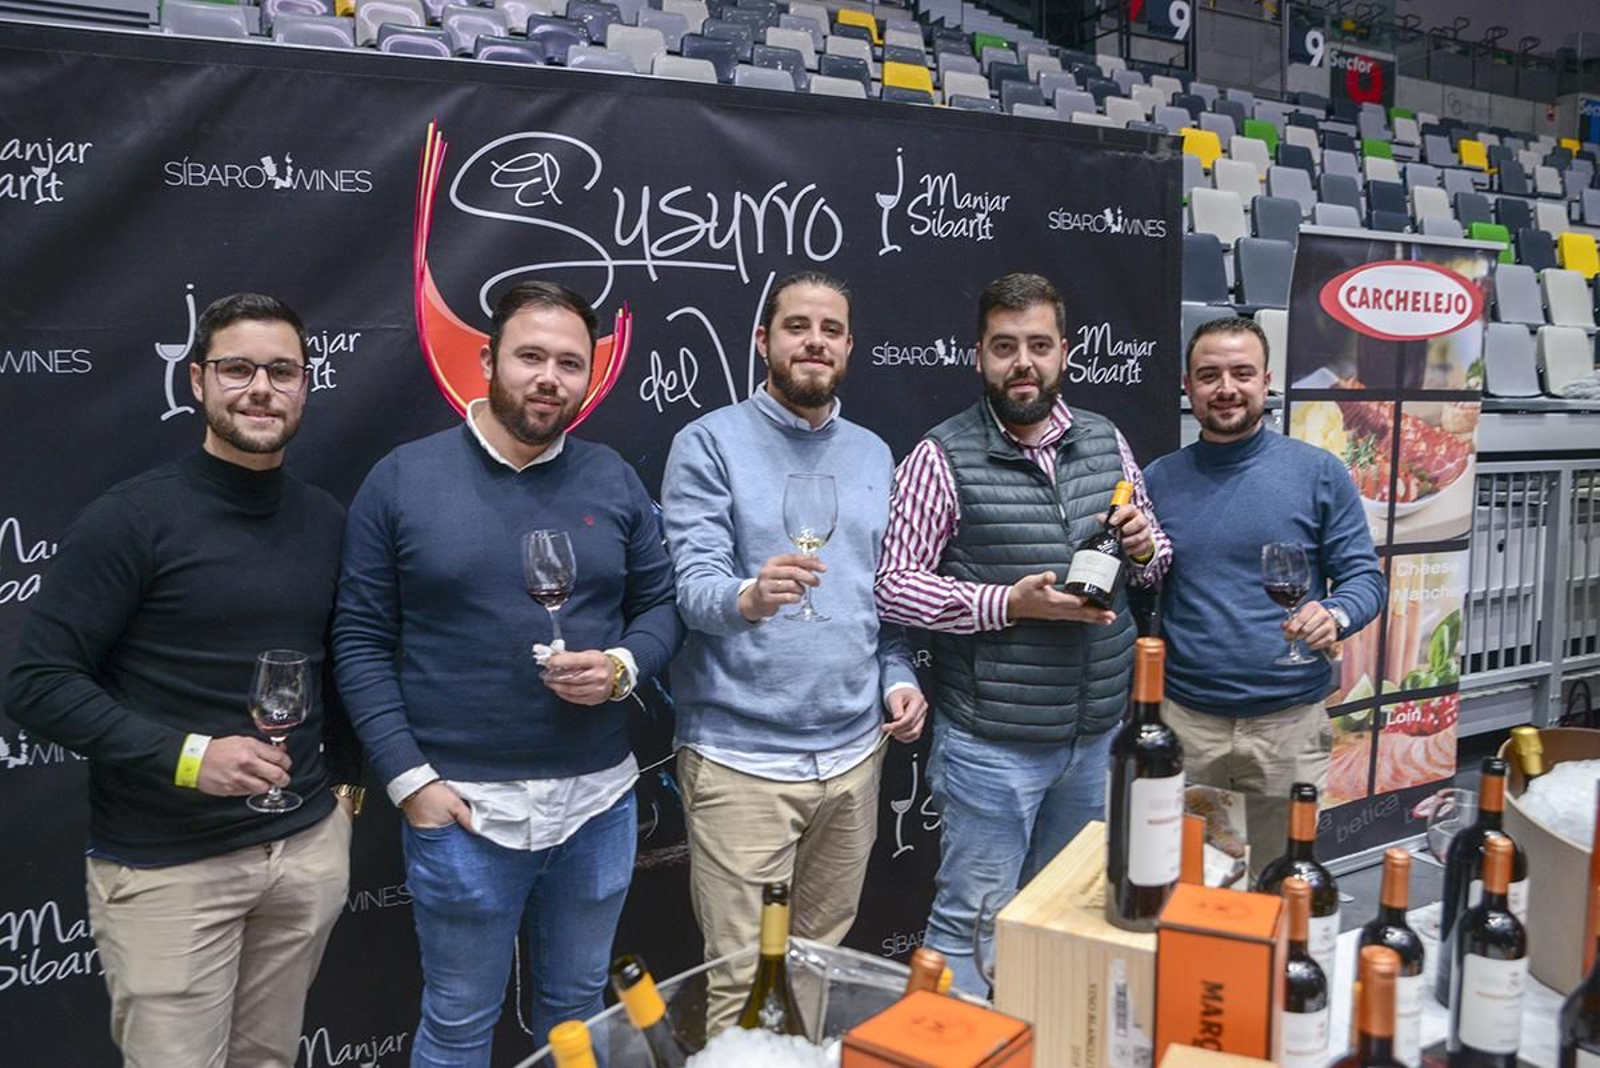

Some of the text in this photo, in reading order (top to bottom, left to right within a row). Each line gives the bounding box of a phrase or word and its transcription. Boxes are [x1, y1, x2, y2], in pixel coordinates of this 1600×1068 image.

[1168, 0, 1190, 40] 9
[1305, 30, 1324, 67] 9
[1329, 50, 1373, 75] Sector
[164, 156, 373, 193] SÍBARO WINES
[490, 152, 563, 207] El
[919, 172, 1011, 215] Manjar
[1119, 218, 1168, 238] WINES
[1345, 285, 1467, 315] CARCHELEJO
[872, 341, 940, 366] SÍBARO
[1077, 322, 1157, 360] Manjar
[639, 346, 702, 412] del
[1192, 979, 1224, 1051] MARQ
